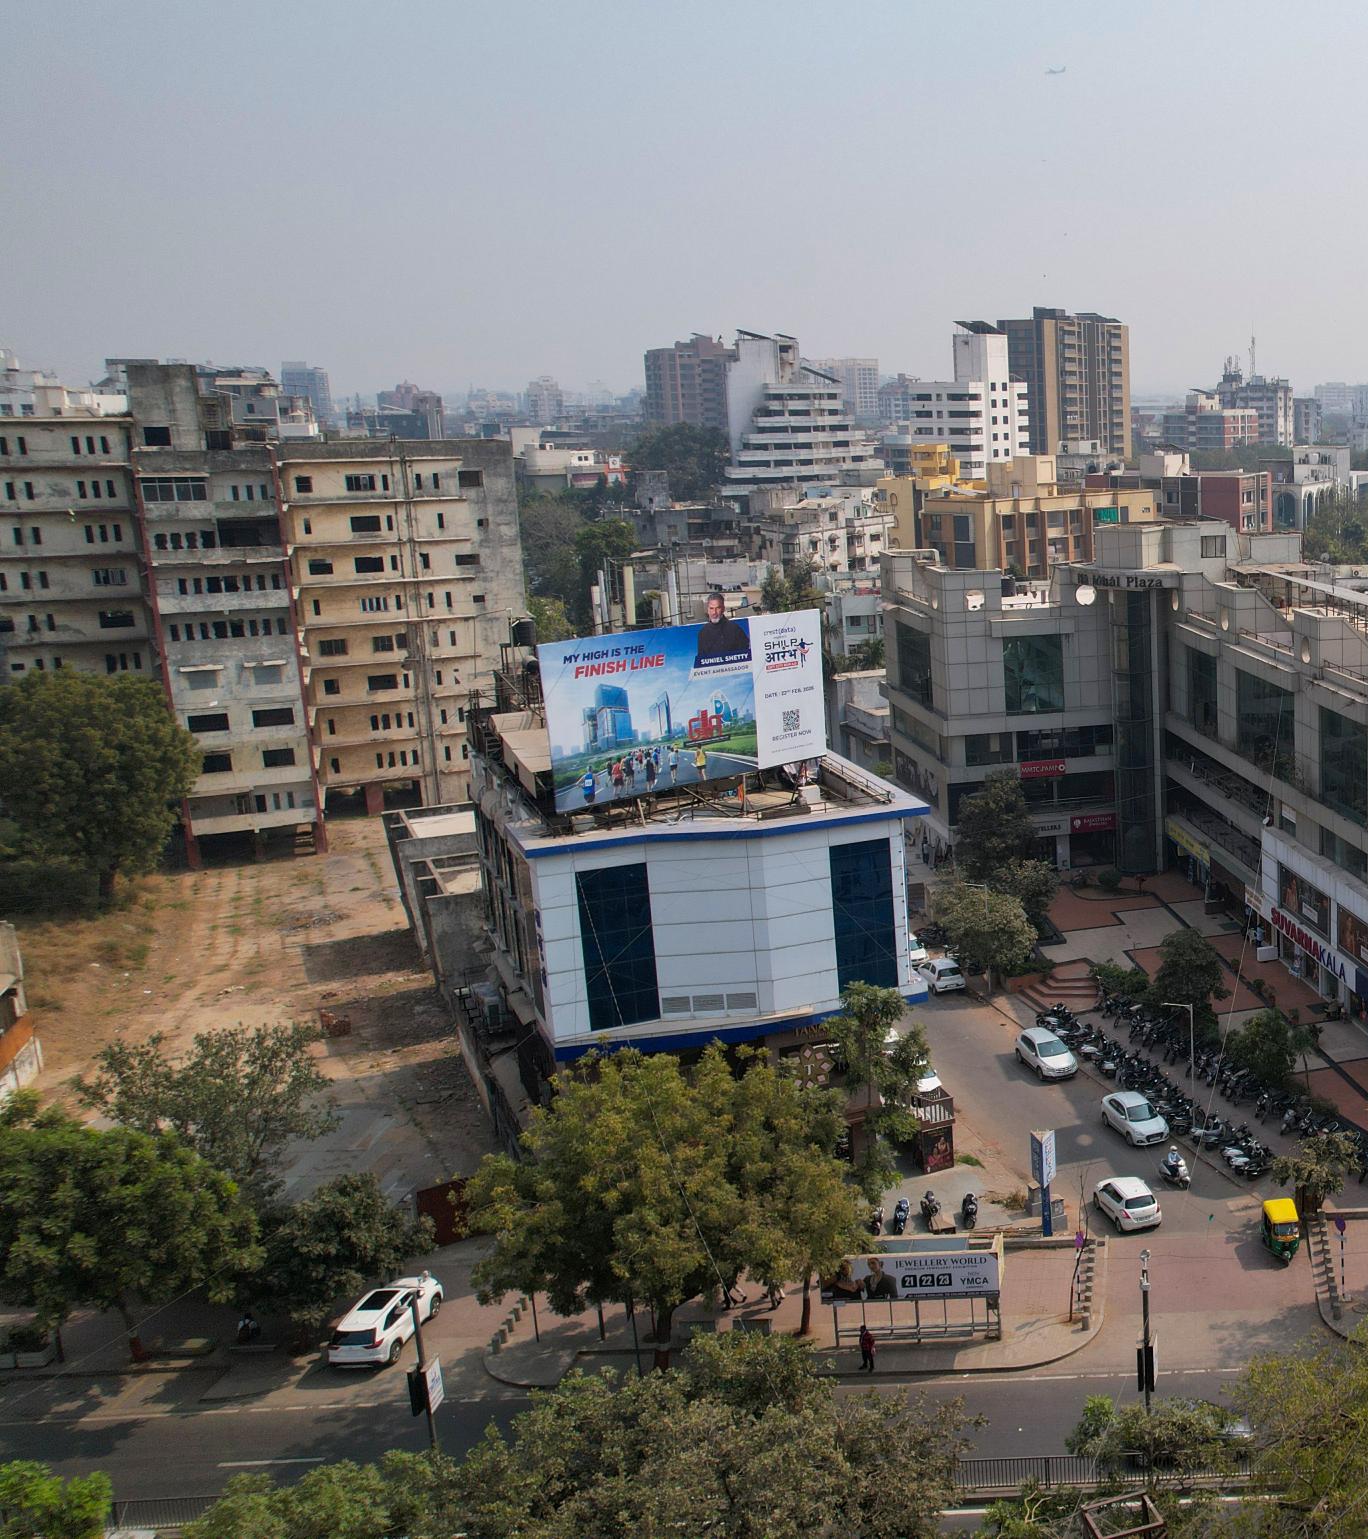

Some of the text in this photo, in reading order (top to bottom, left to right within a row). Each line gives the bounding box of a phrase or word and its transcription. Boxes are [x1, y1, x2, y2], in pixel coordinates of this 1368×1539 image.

[1126, 576, 1163, 588] Plaza
[764, 638, 799, 651] SHILP
[563, 645, 645, 666] MY HIGH IS THE
[724, 652, 749, 662] SHETTY
[574, 654, 665, 680] FINISH LINE
[693, 664, 750, 677] EVENT AMBASSADOR
[764, 690, 778, 699] DATE
[772, 728, 812, 742] REGISTER NOW
[1270, 906, 1346, 984] SUVARNAKALA
[895, 1256, 988, 1269] JEWELLERY WORLD
[904, 1274, 950, 1286] 21 22 23
[960, 1276, 989, 1286] YMCA
